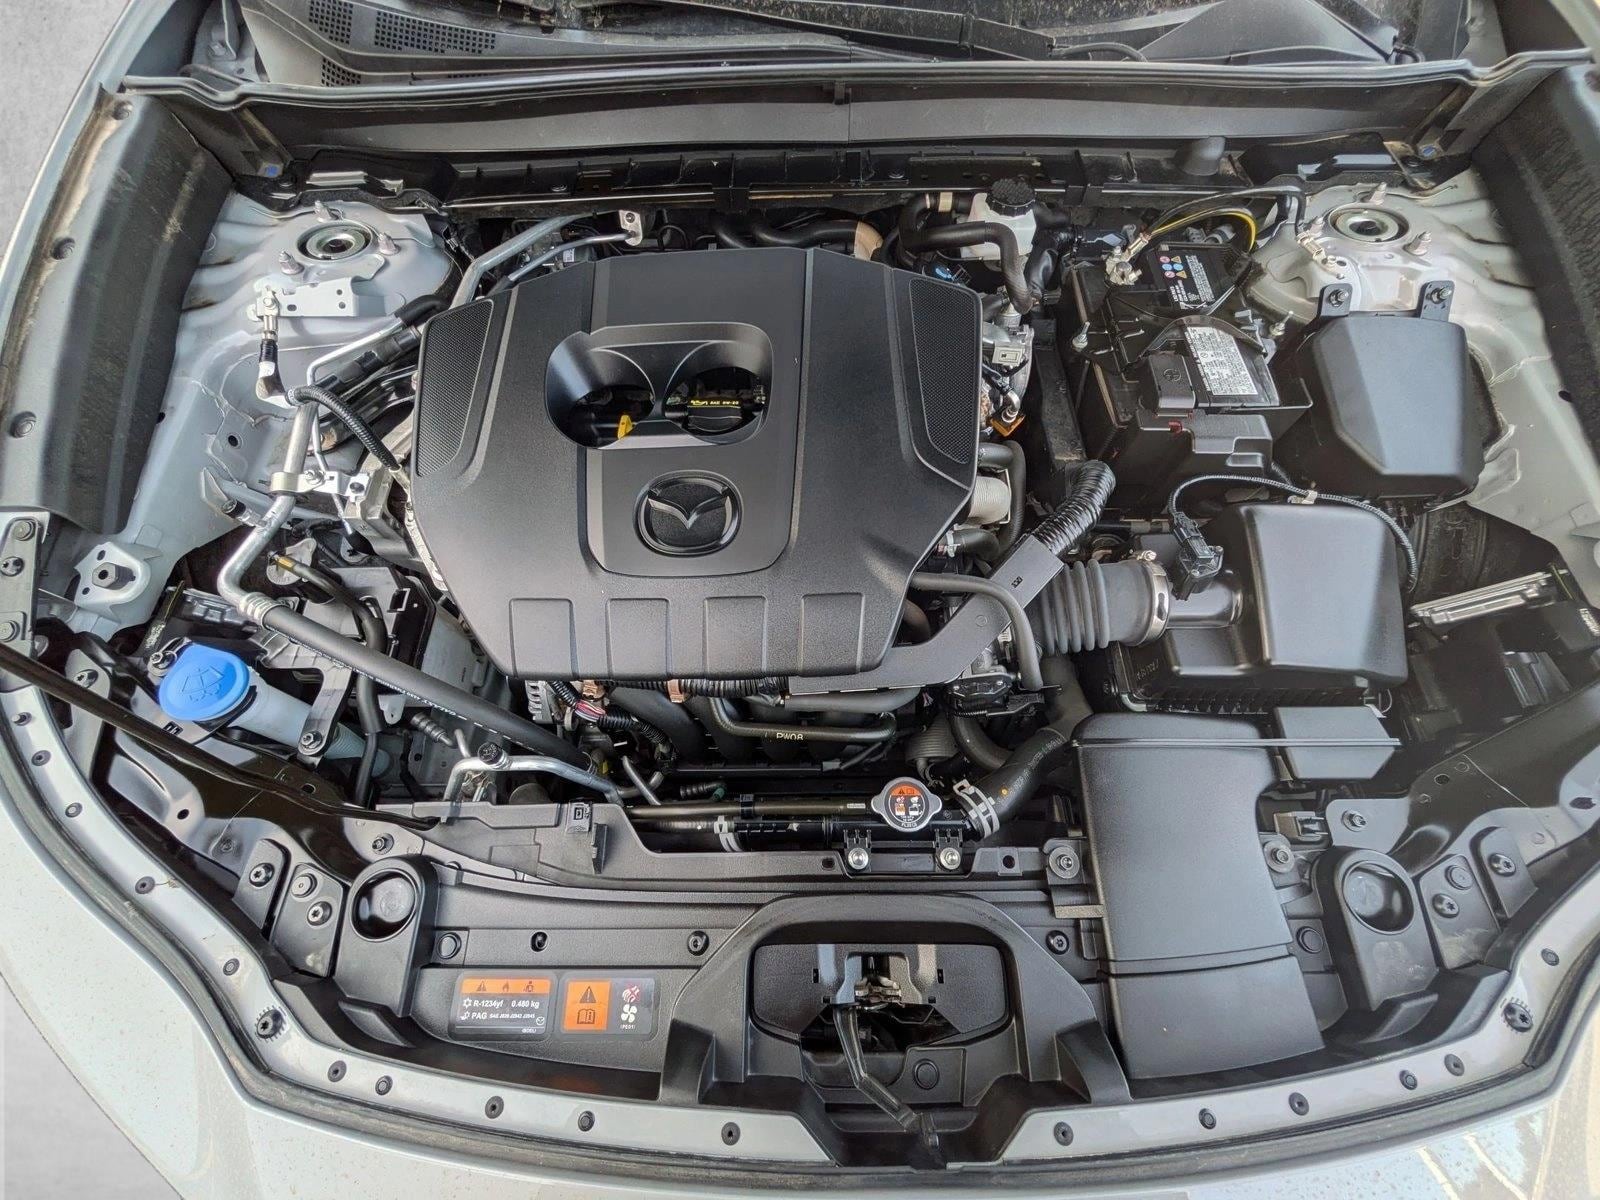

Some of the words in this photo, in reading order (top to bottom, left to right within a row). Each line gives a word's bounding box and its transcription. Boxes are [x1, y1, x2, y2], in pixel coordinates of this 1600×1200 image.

[473, 999, 504, 1009] R-1234yf
[530, 1000, 540, 1009] kg
[471, 1011, 487, 1020] PAG
